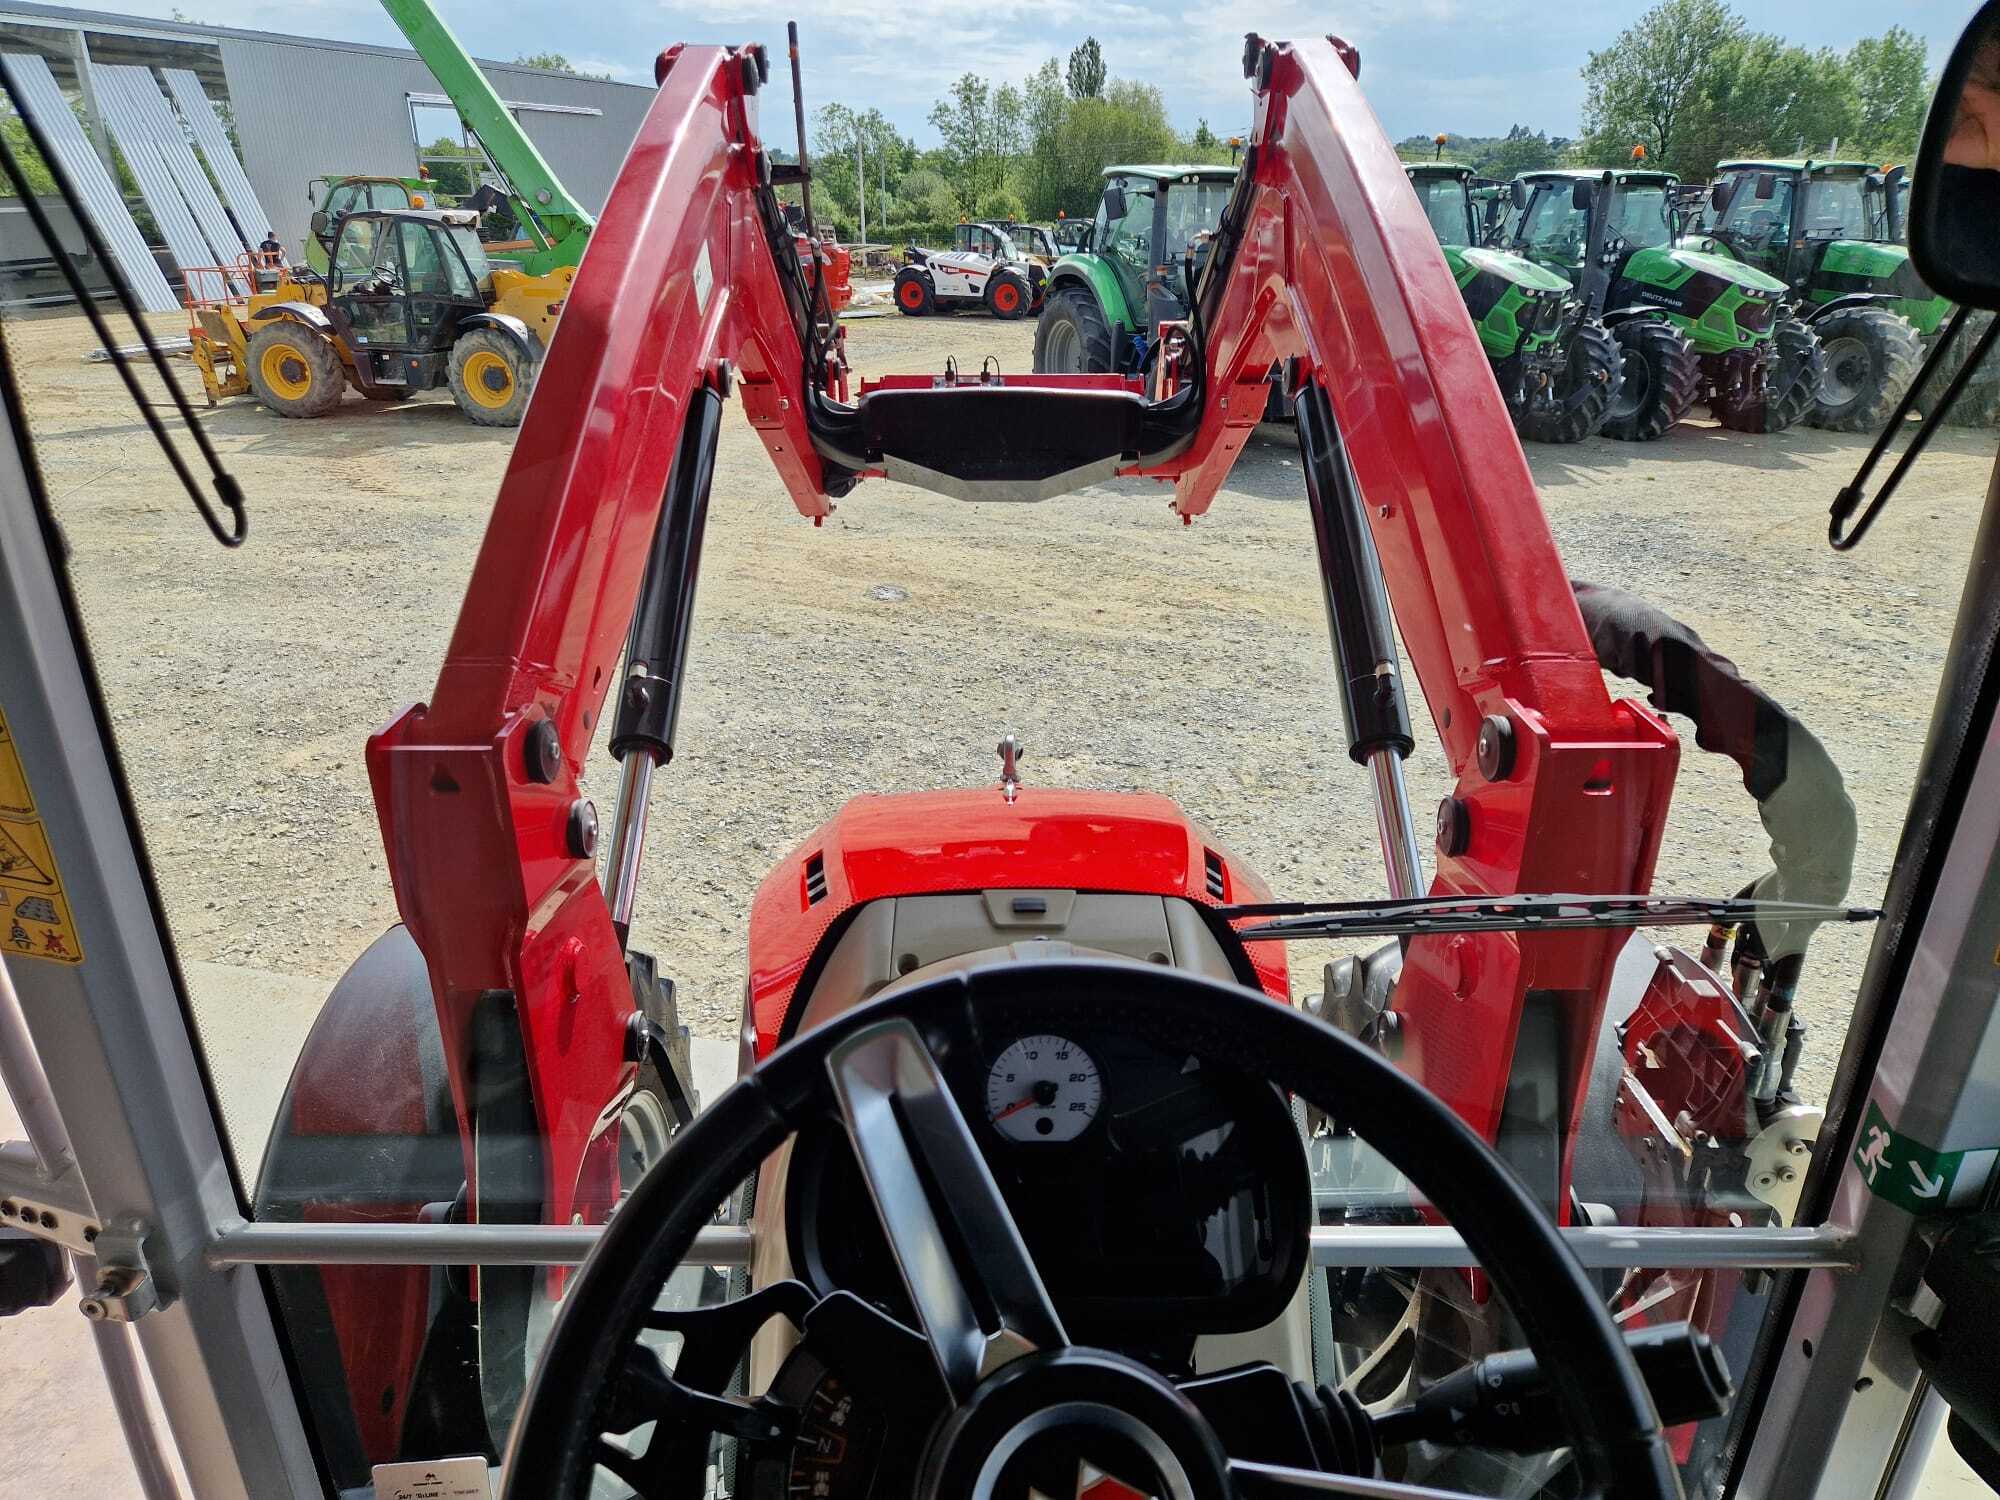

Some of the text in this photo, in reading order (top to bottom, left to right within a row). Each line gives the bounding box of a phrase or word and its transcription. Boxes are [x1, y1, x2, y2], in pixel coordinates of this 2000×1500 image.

[1024, 1051, 1038, 1060] 10
[1055, 1051, 1069, 1060] 15
[1006, 1073, 1016, 1082] 5
[1069, 1073, 1086, 1082] 20
[1069, 1102, 1086, 1111] 25
